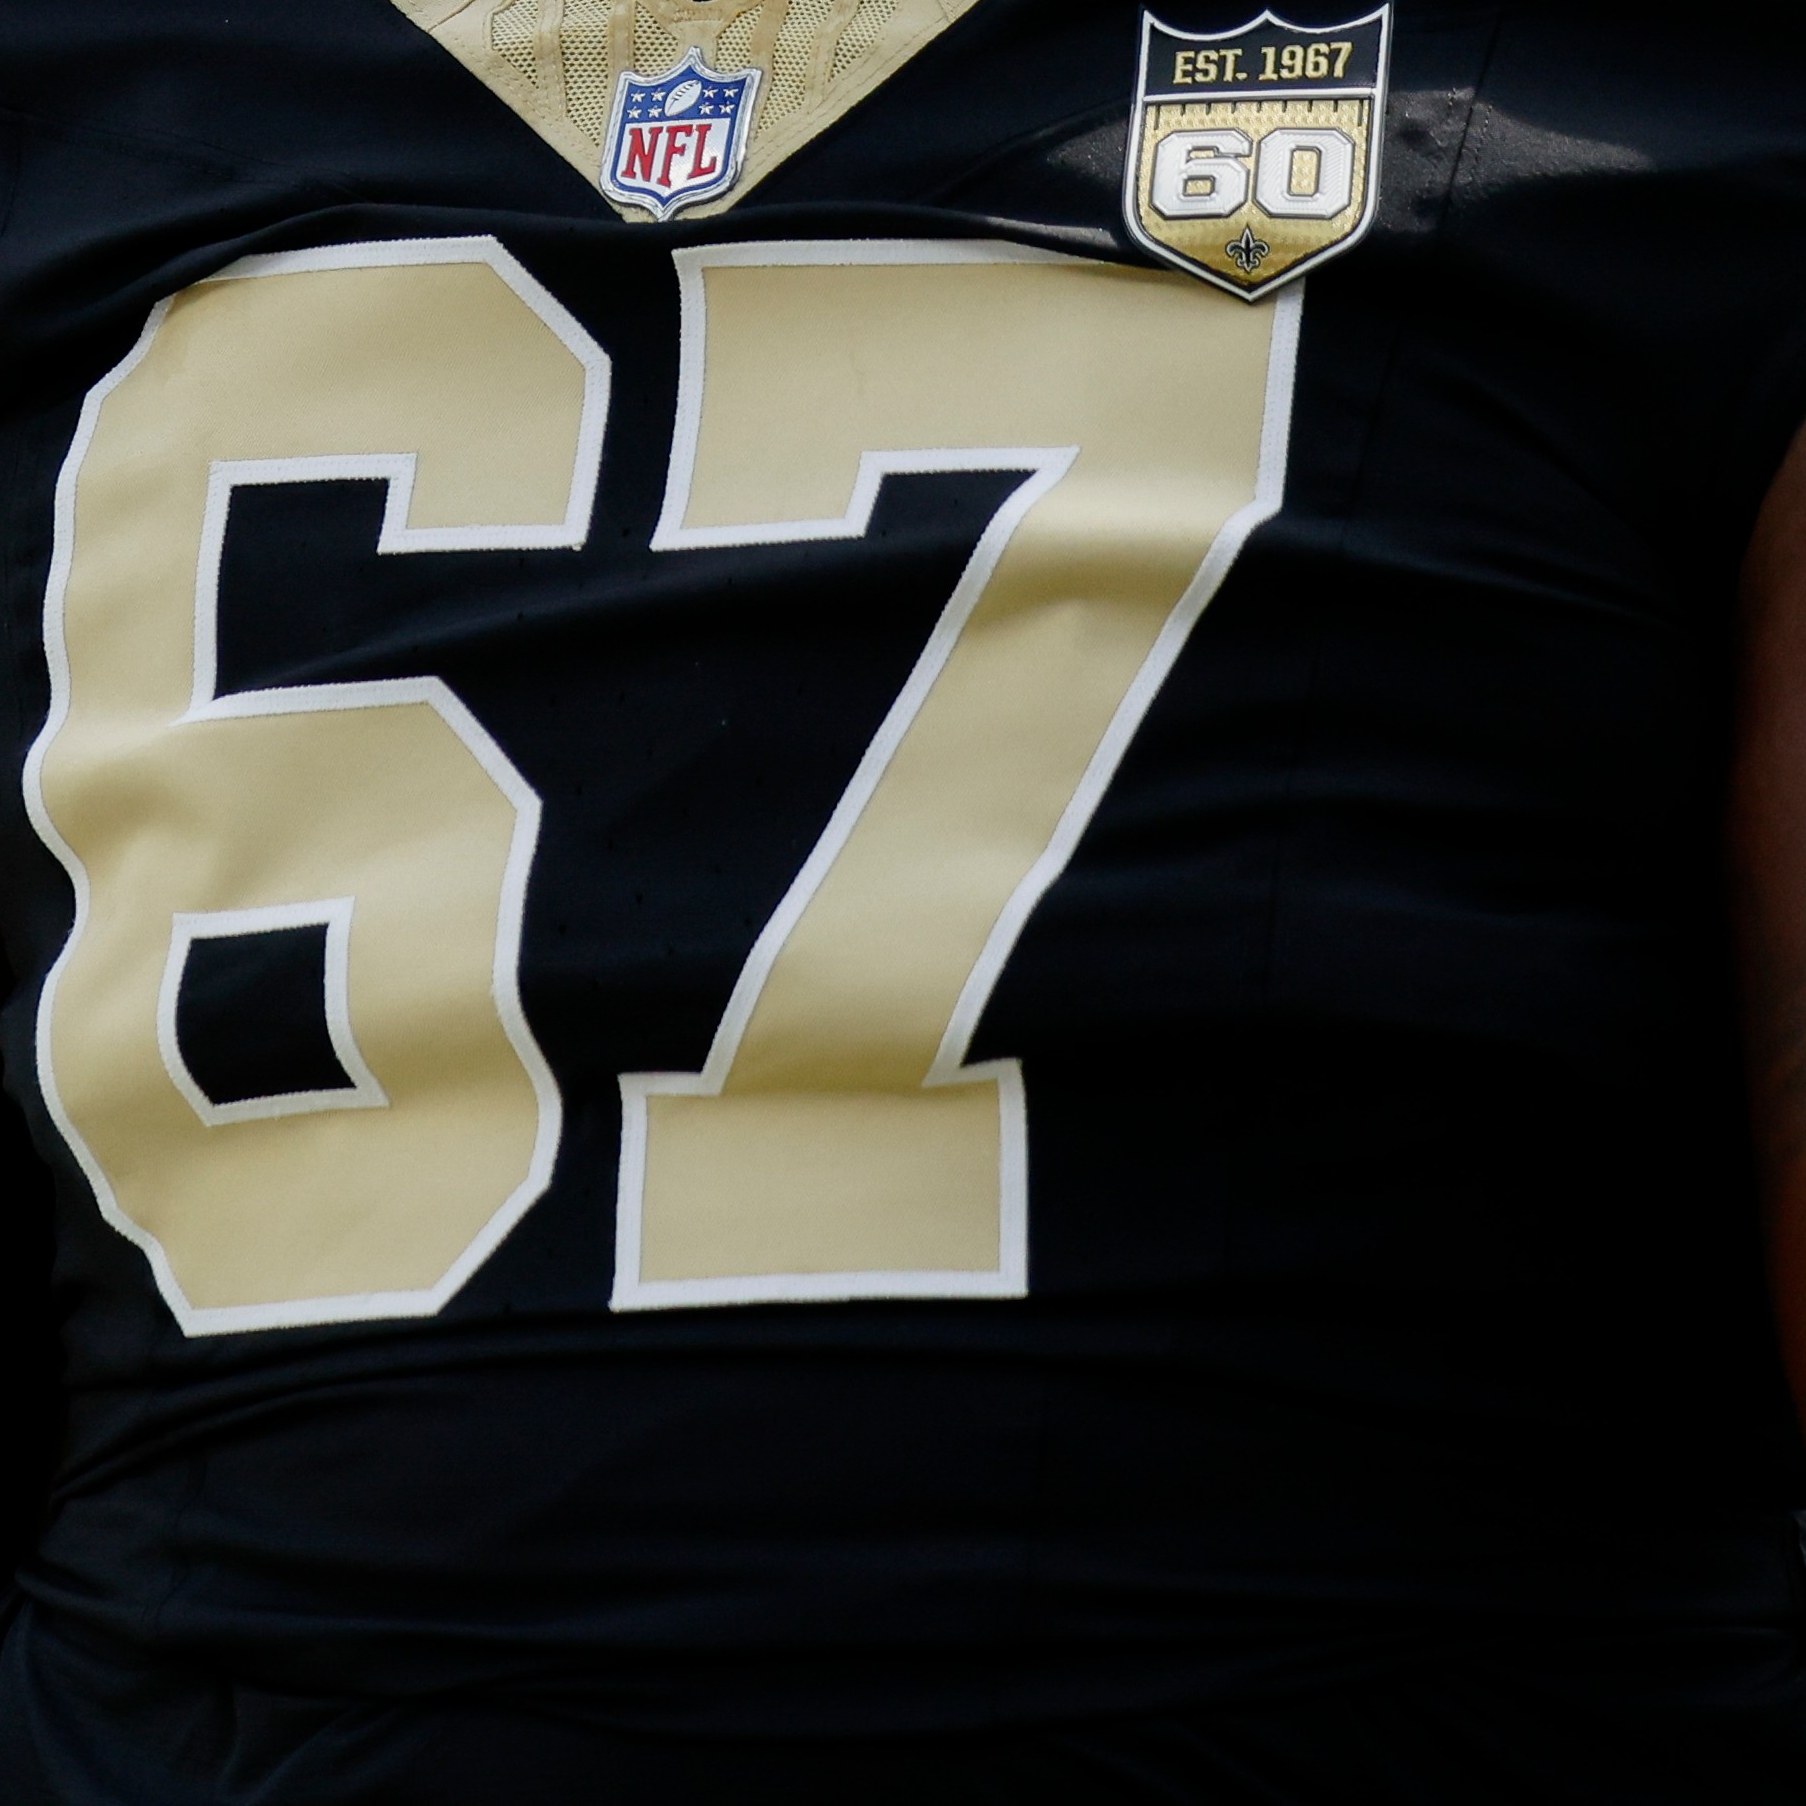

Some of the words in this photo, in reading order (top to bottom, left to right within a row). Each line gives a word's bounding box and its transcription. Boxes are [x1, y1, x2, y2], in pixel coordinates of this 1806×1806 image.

[1171, 47, 1249, 85] EST.
[1258, 41, 1354, 82] 1967
[620, 123, 719, 189] NFL
[1148, 126, 1357, 222] 60
[22, 234, 1305, 1338] 67
